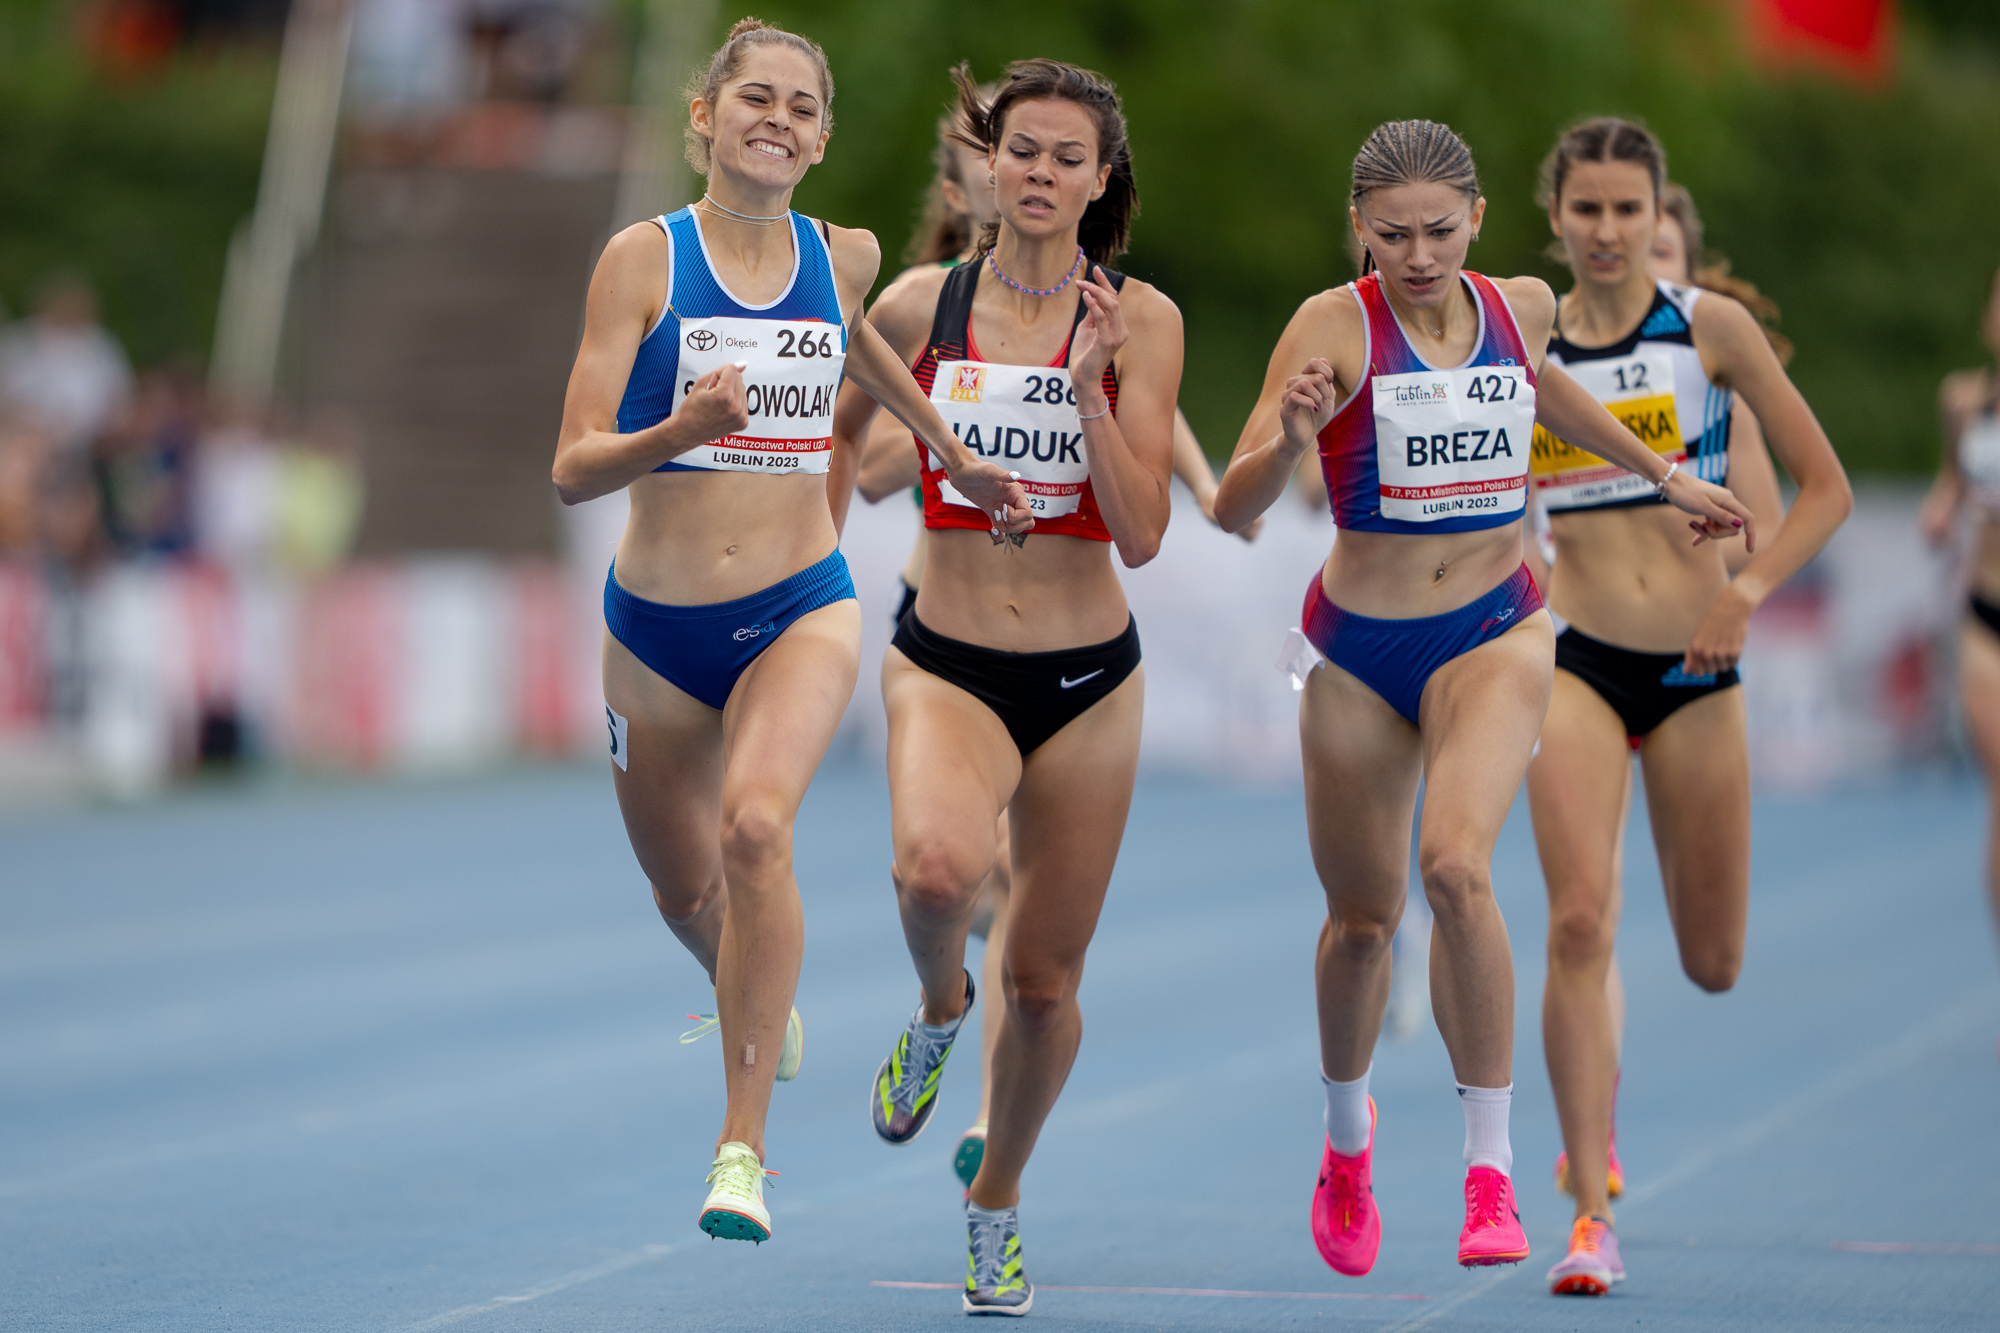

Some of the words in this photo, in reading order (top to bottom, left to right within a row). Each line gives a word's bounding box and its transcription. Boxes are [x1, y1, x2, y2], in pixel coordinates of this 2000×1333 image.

[725, 337, 758, 349] Okęcie
[777, 329, 833, 359] 266
[1613, 363, 1649, 391] 12
[684, 380, 834, 418] OWOLAK
[1467, 375, 1517, 404] 427
[724, 436, 784, 450] Mistrzostwa
[785, 441, 811, 451] Polski
[812, 440, 826, 450] U20
[1406, 428, 1513, 467] BREZA
[713, 452, 763, 466] LUBLIN
[766, 456, 799, 468] 2023
[1031, 483, 1060, 495] Polski
[1061, 485, 1078, 495] U20
[1389, 487, 1403, 498] 77.
[1404, 489, 1429, 499] PZLA
[1430, 484, 1482, 498] Mistrzostwa
[1484, 480, 1509, 492] Polski
[1510, 477, 1524, 488] U20
[1027, 497, 1046, 510] 23
[1423, 499, 1464, 515] LUBLIN
[1467, 497, 1498, 510] 2023
